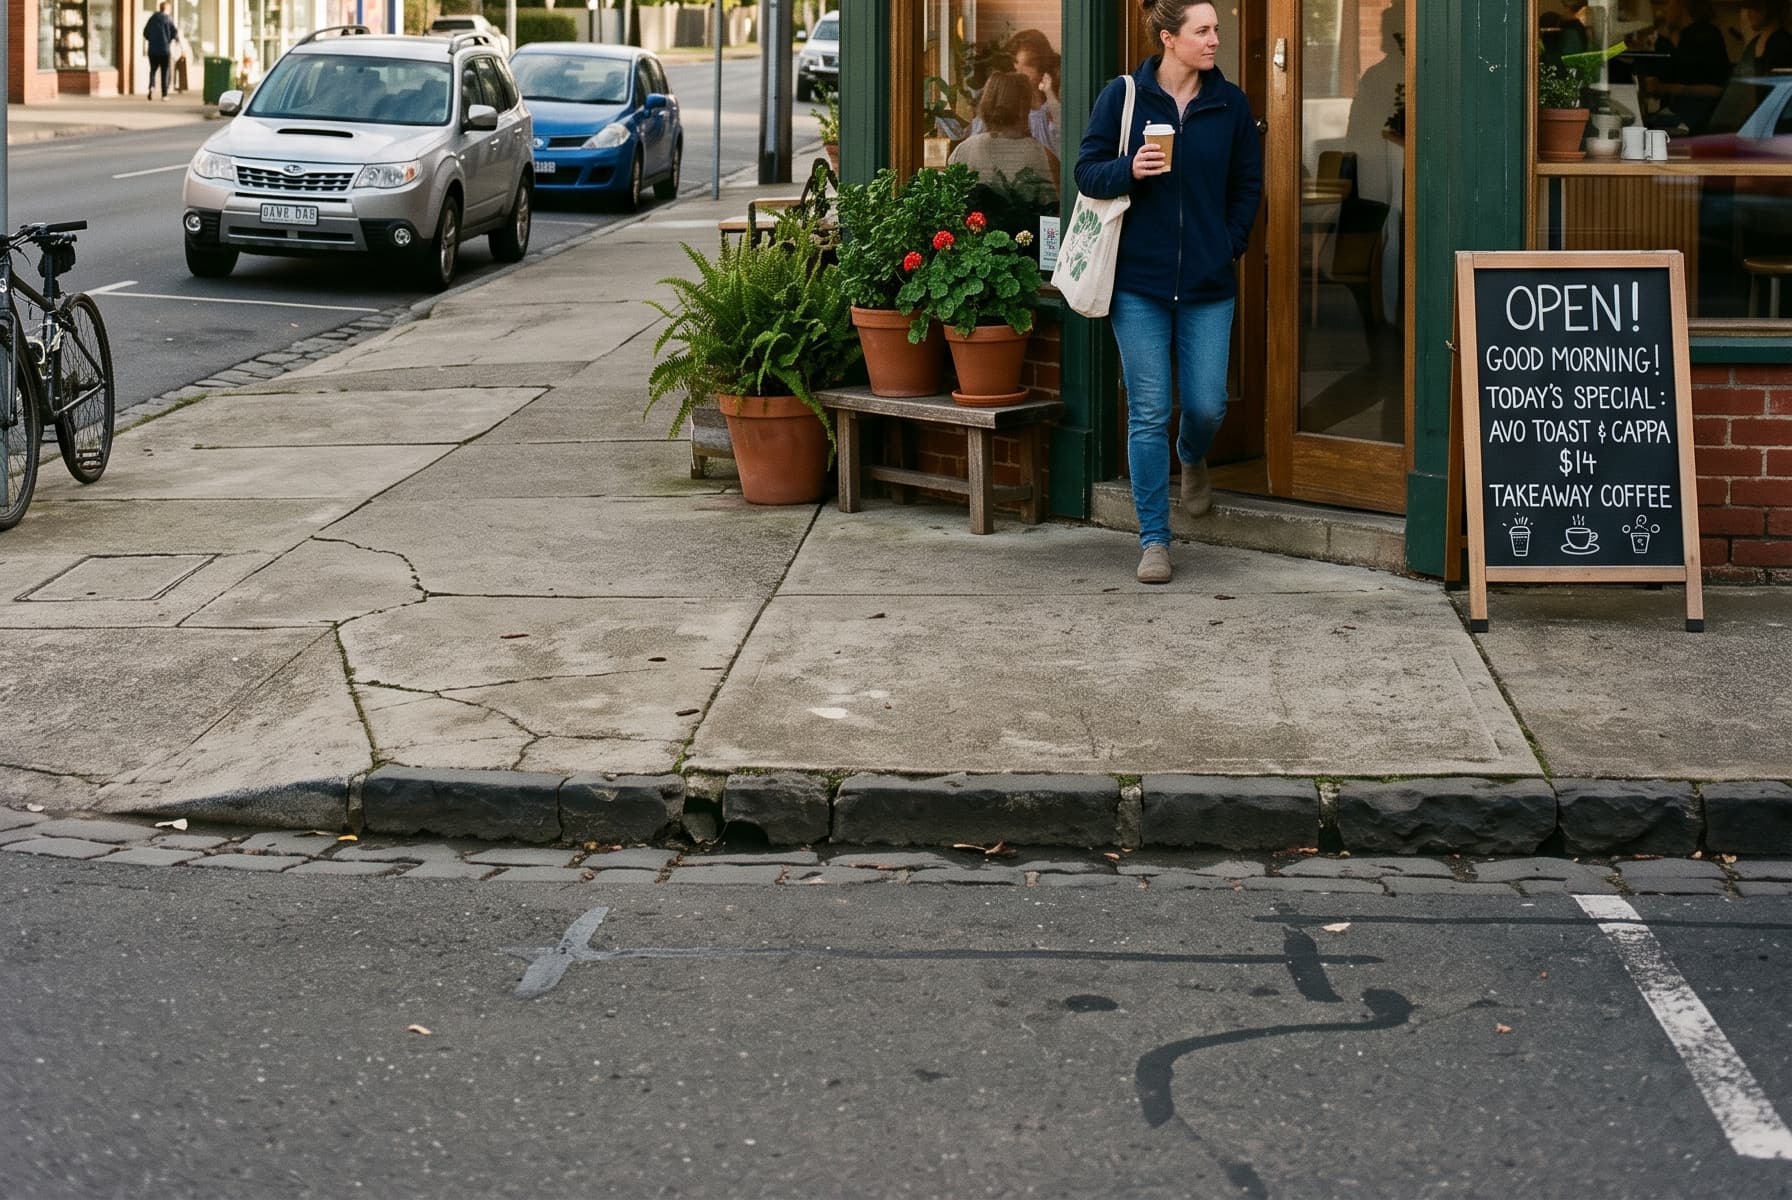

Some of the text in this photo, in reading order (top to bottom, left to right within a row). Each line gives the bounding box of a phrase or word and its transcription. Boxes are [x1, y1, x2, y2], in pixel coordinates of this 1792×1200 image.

[1505, 281, 1640, 333] OPEN!
[1486, 343, 1660, 376] GOOD MORNING!
[1485, 382, 1666, 410] TODAY'S SPECIAL:
[1488, 419, 1526, 444] AVO
[1531, 419, 1592, 444] TOAST
[1611, 419, 1671, 444] CAPPA
[1559, 447, 1597, 478] $14
[1488, 484, 1673, 509] TAKEAWAY COFFEE
